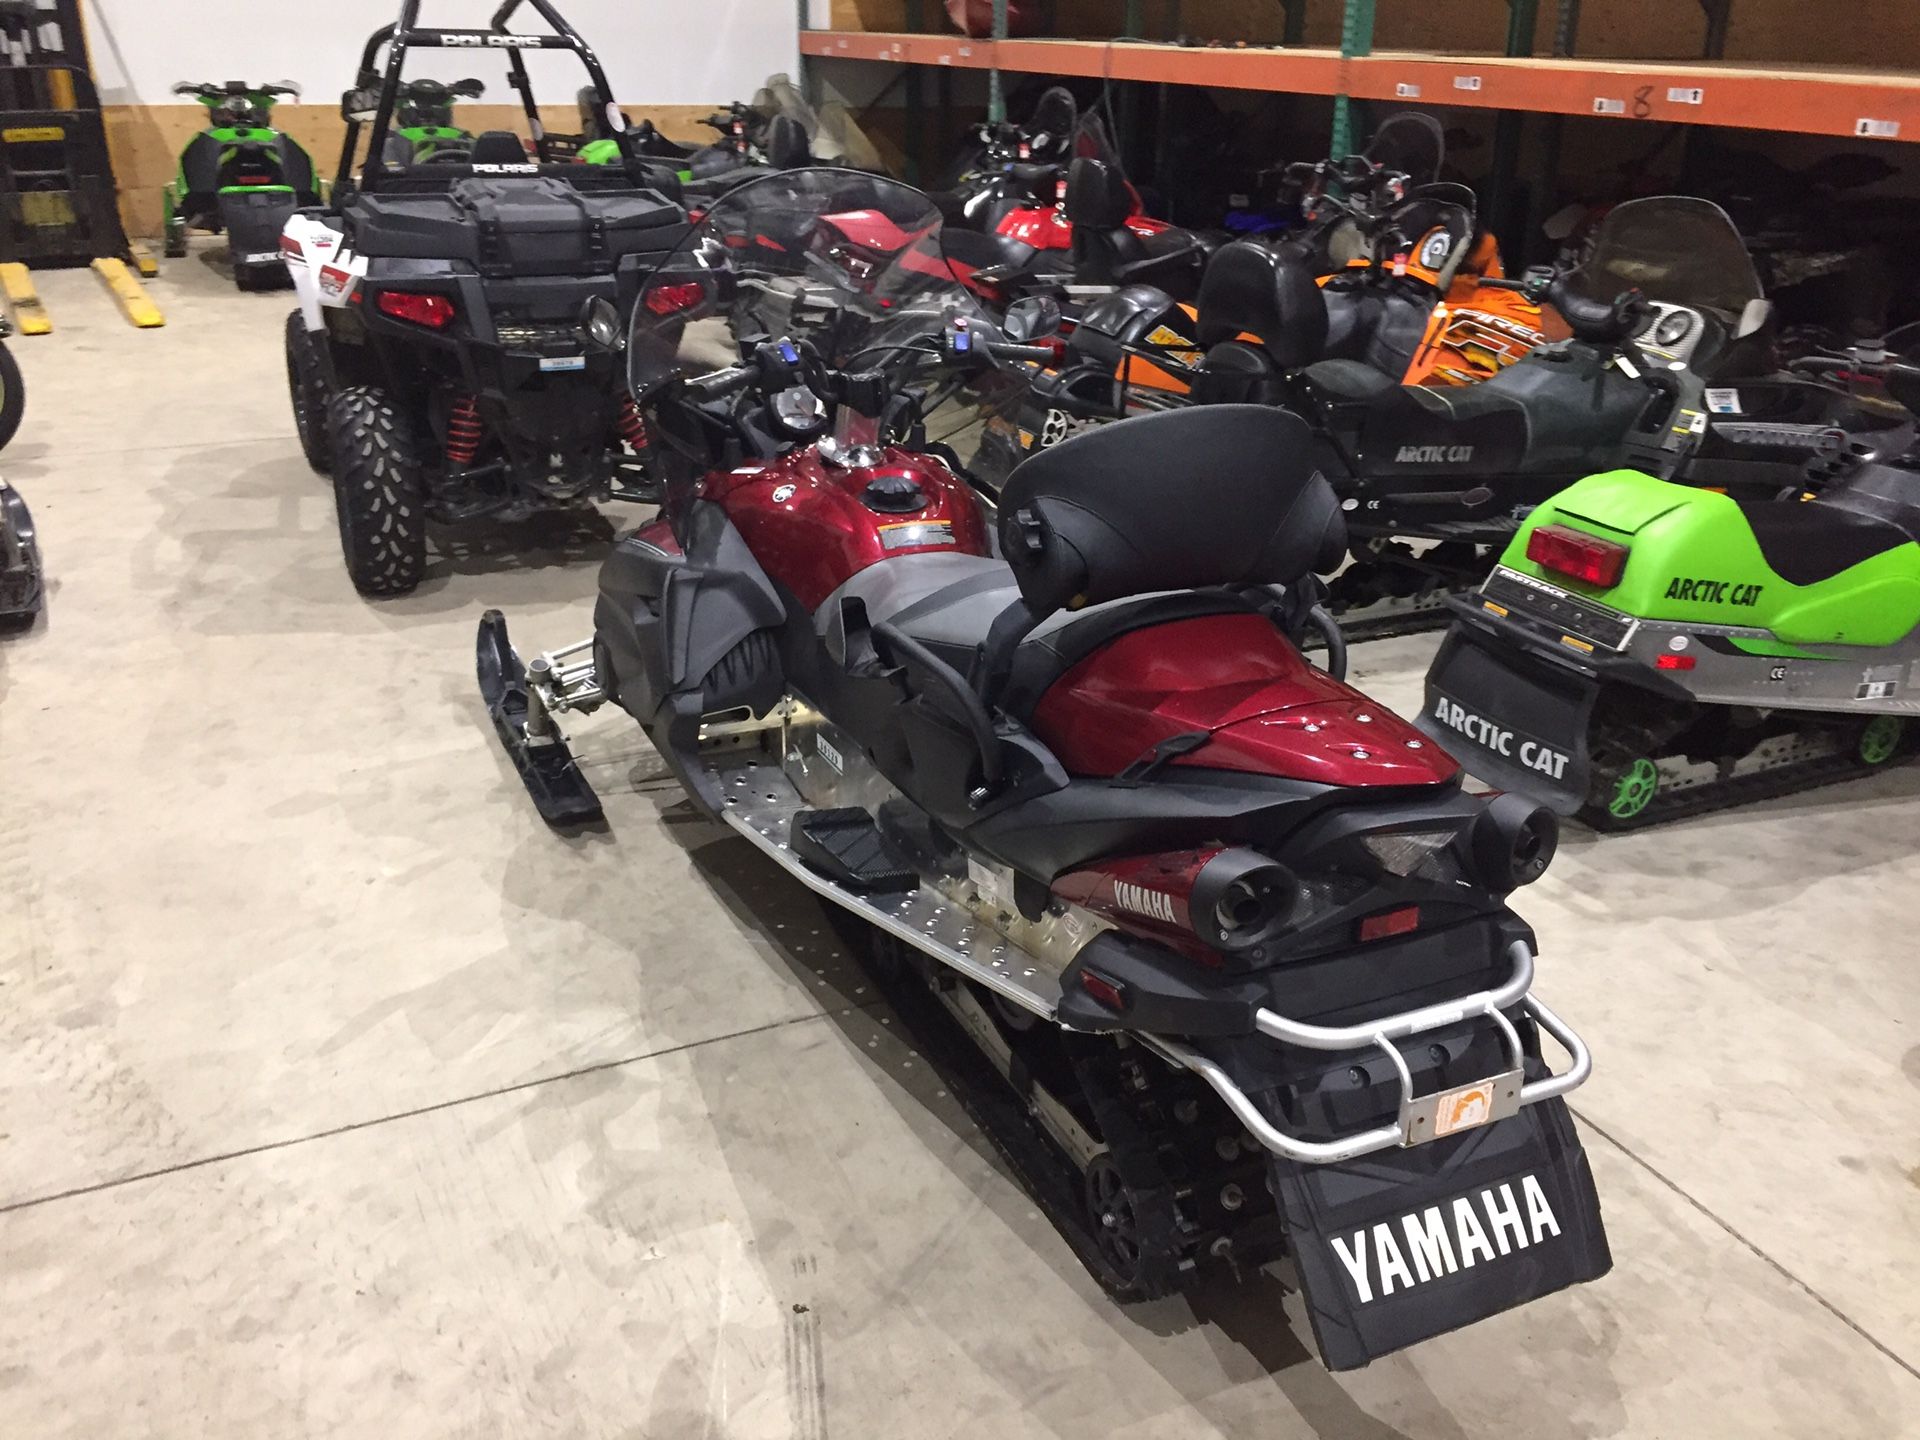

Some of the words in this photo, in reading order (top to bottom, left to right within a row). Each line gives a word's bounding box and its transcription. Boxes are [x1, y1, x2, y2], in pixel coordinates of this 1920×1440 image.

[440, 34, 541, 47] POLARIS
[1633, 85, 1655, 118] 8
[472, 163, 538, 173] POLARIS
[1395, 446, 1446, 462] ARCTIC
[1447, 446, 1474, 462] CAT
[1499, 569, 1568, 599] FASTRACK
[1664, 577, 1729, 604] ARCTIC
[1730, 583, 1763, 606] CAT
[1435, 697, 1514, 757] ARCTIC
[1520, 741, 1569, 780] CAT
[1114, 879, 1177, 923] YAMAHA
[1330, 1174, 1561, 1303] YAMAHA
